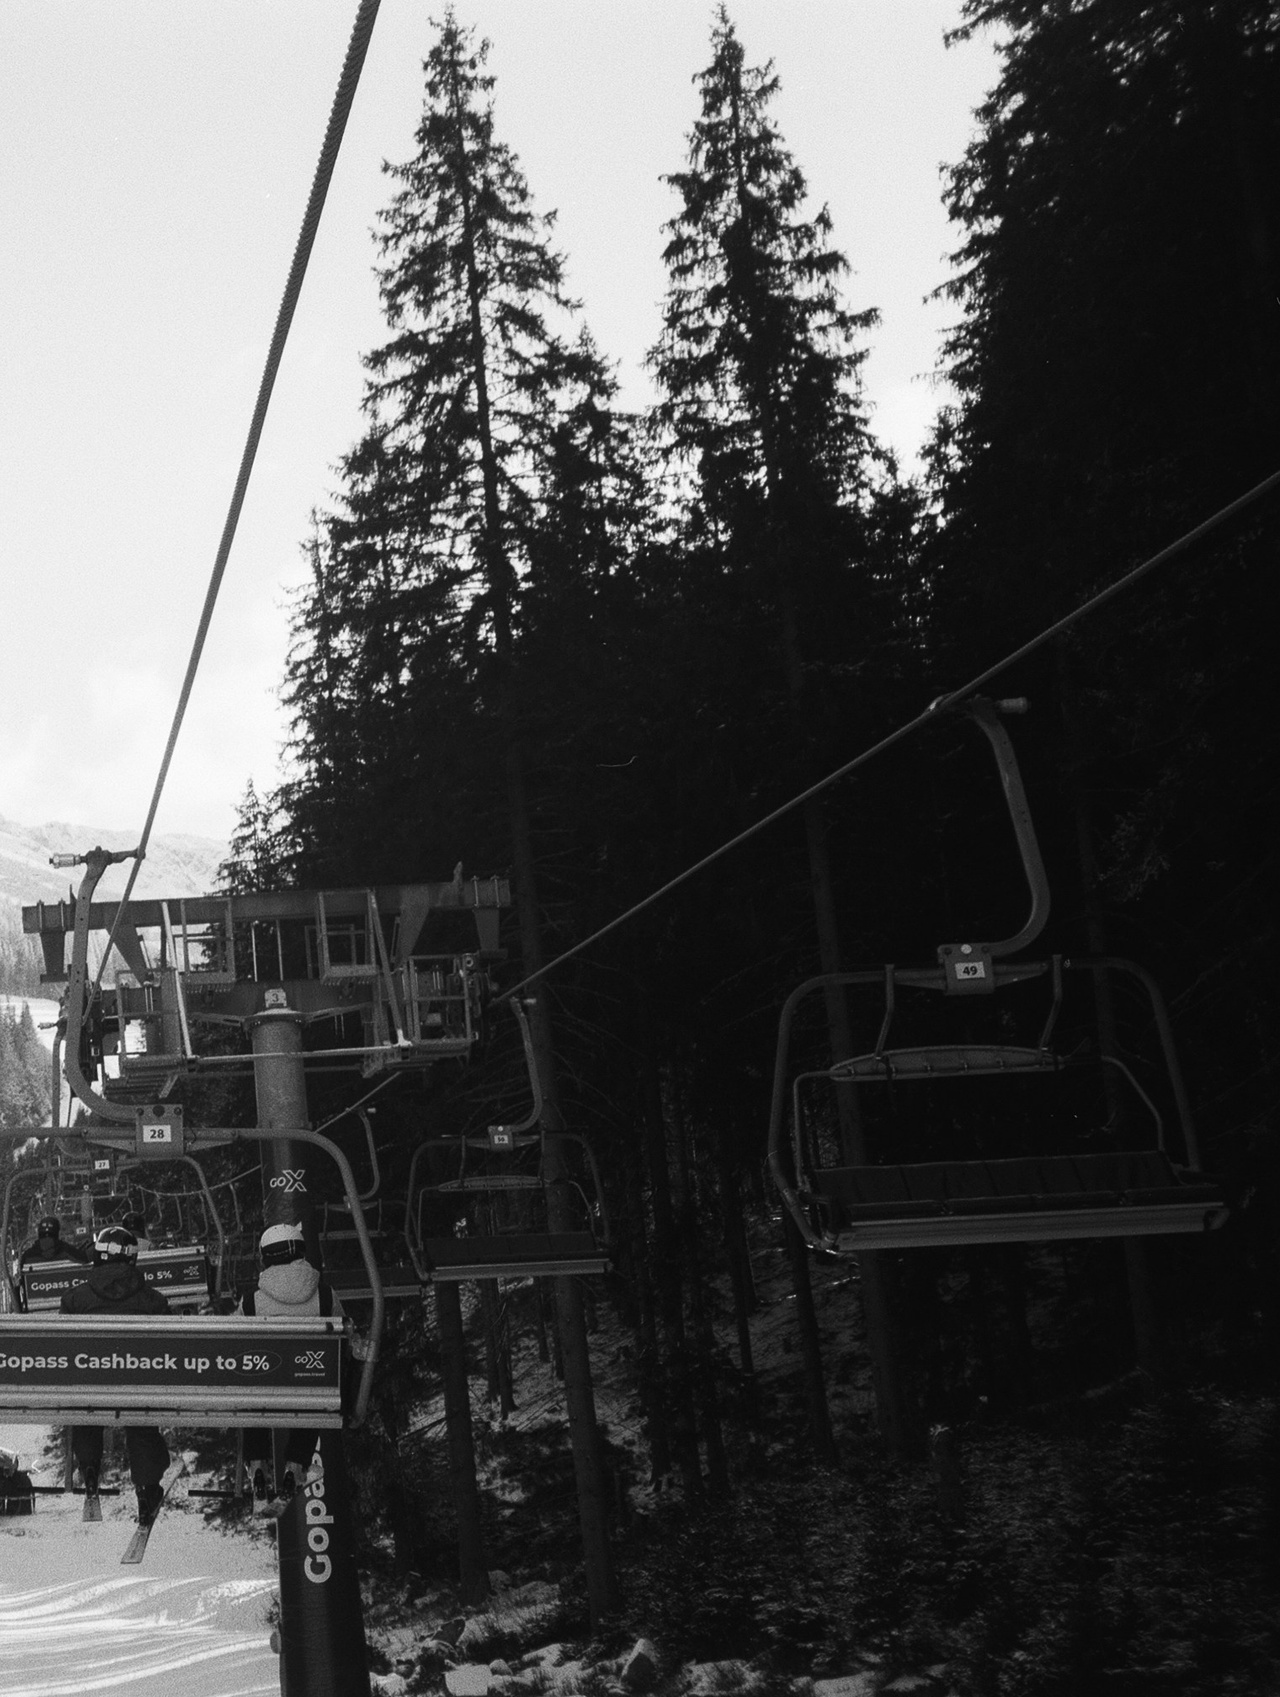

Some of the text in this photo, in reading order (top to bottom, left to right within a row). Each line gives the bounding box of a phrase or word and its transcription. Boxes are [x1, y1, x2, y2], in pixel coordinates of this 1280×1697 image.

[963, 966, 978, 976] 49
[272, 993, 279, 1003] 3
[150, 1129, 165, 1139] 28
[31, 1281, 70, 1291] Gopass
[157, 1270, 173, 1280] 5%
[74, 1353, 178, 1369] Cashback
[184, 1357, 210, 1373] up
[216, 1355, 237, 1370] to
[242, 1355, 270, 1370] 5%
